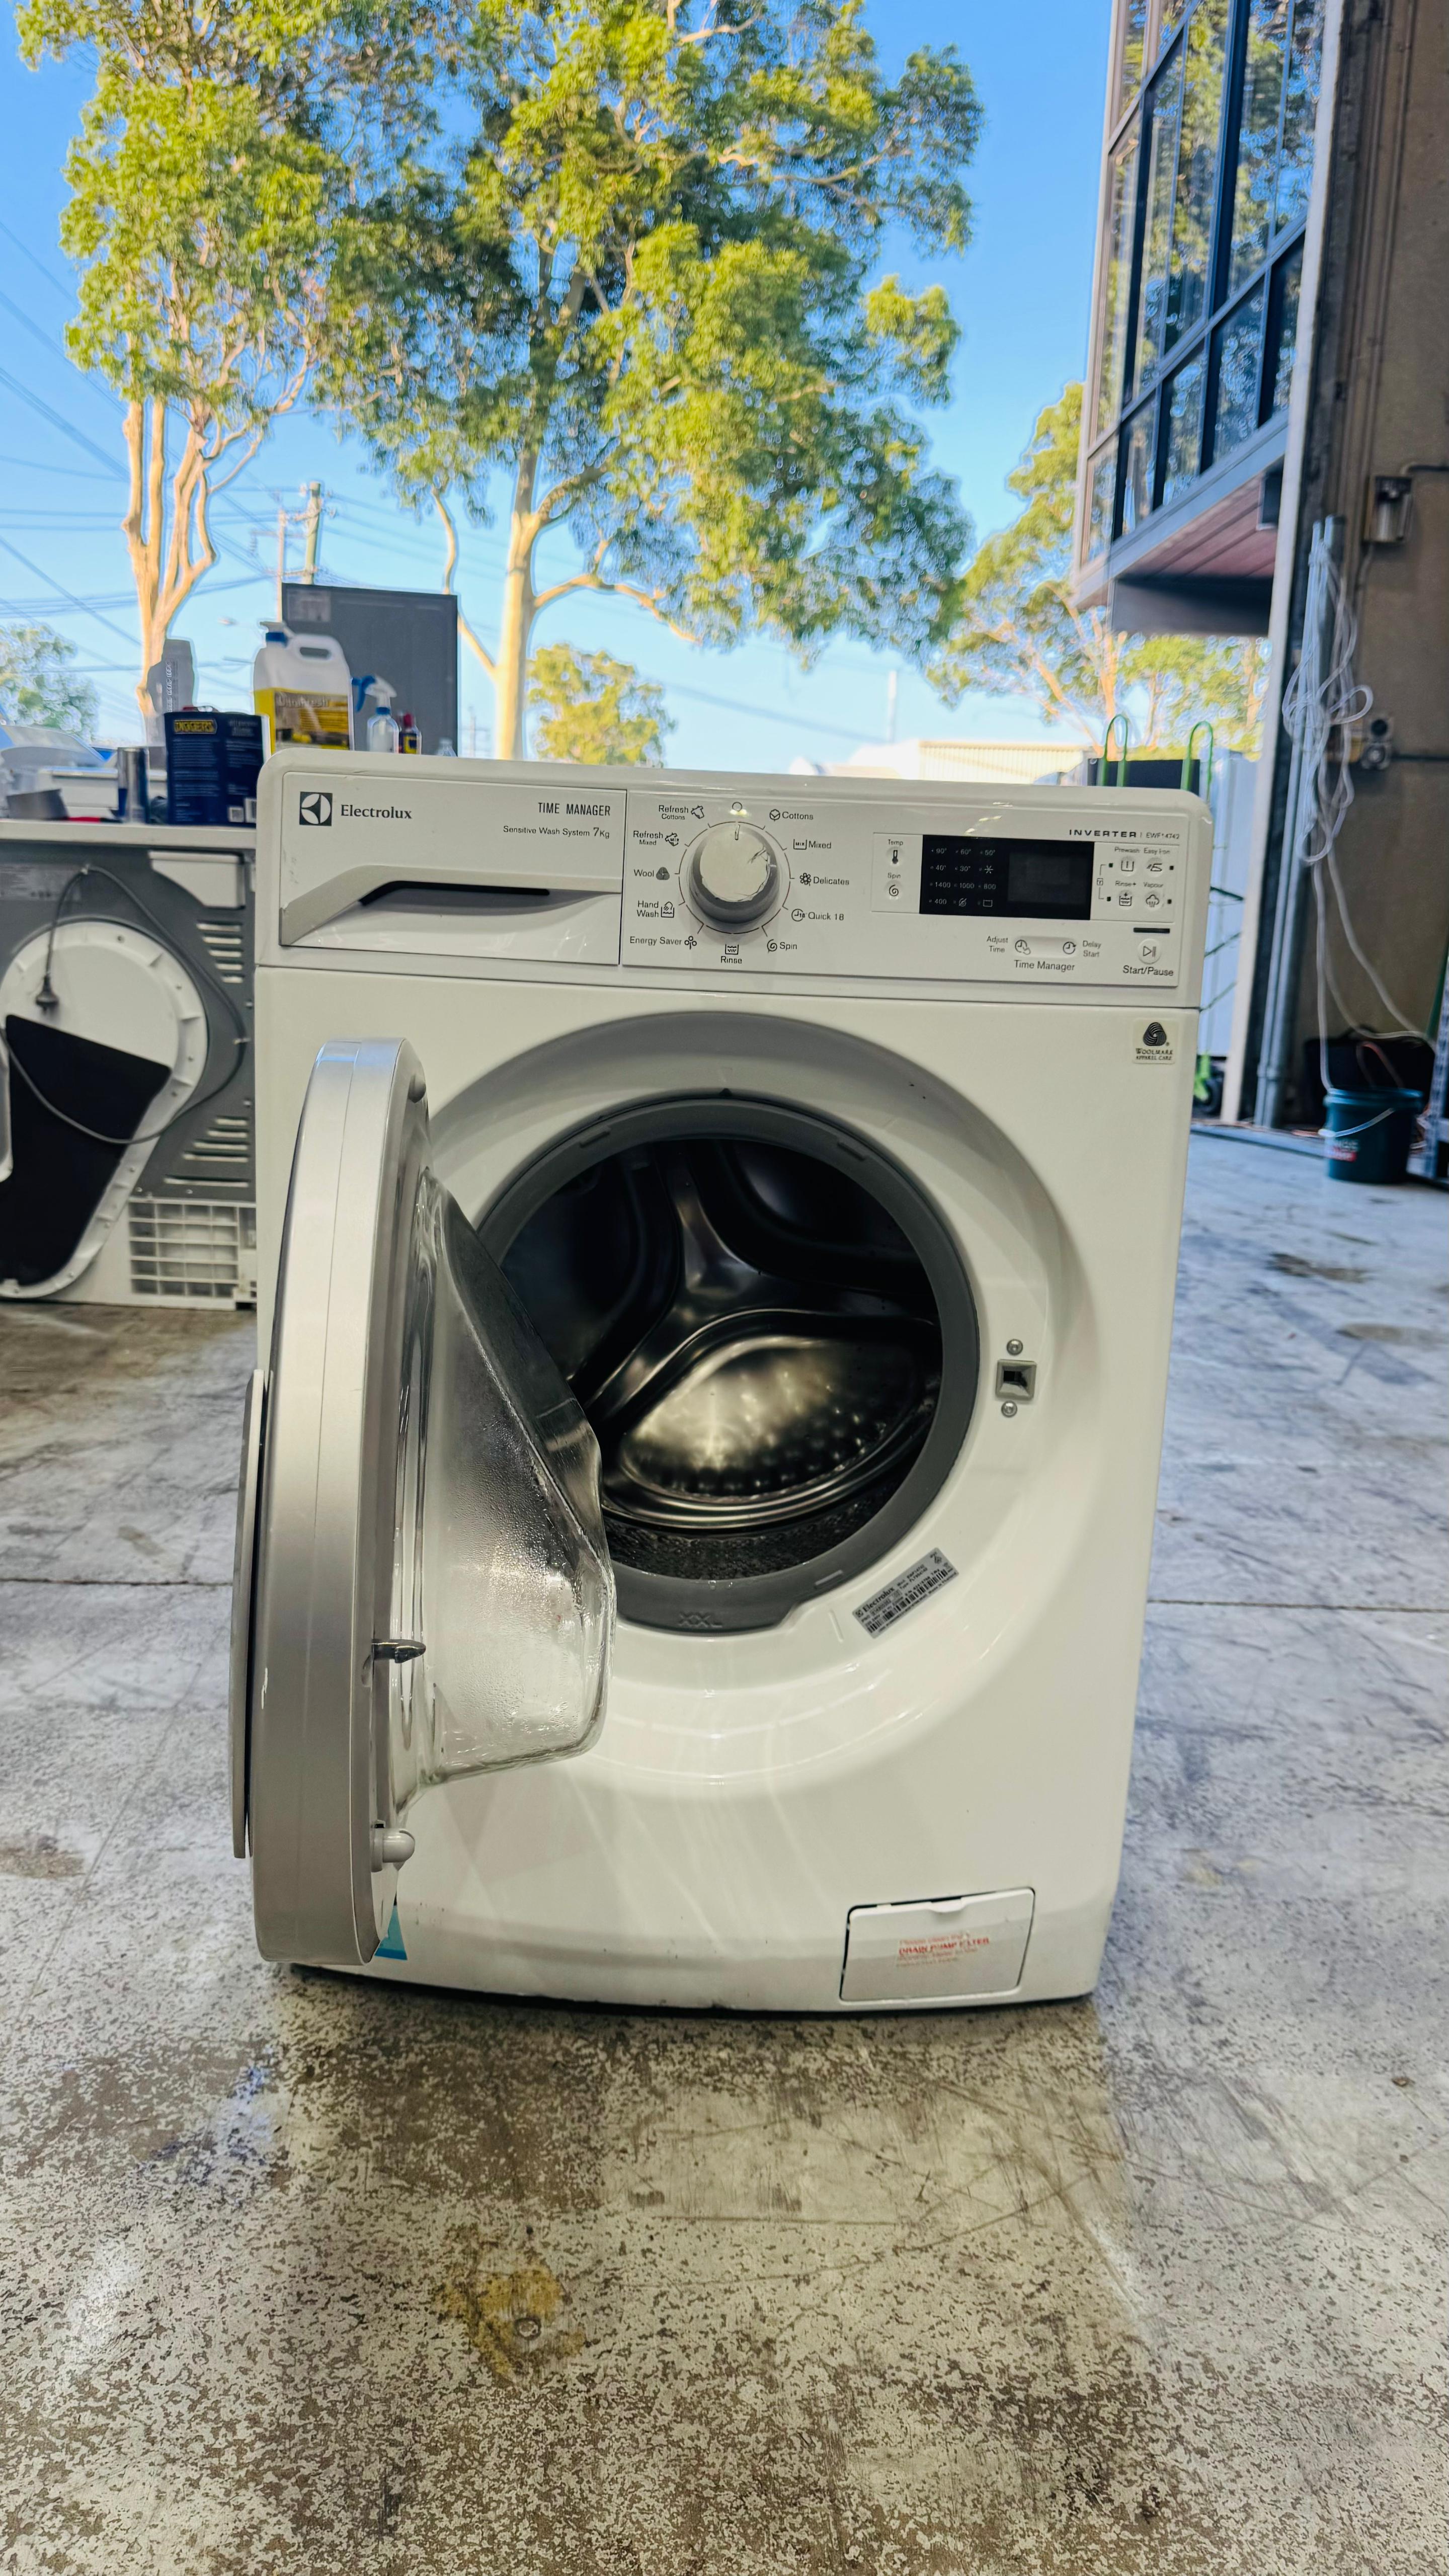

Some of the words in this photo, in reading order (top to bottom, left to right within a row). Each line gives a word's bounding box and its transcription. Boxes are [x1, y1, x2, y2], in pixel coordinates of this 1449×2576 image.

[341, 804, 412, 819] Electrolux
[538, 802, 560, 814] TIME
[566, 803, 610, 816] MANAGER
[658, 805, 689, 813] Refresh
[782, 811, 814, 820] Cottons
[503, 825, 536, 834] Sensitive
[539, 827, 560, 835] Wash
[562, 828, 590, 837] System
[633, 830, 663, 839] Refresh
[1069, 829, 1137, 838] INVERTER
[809, 840, 832, 849] Mixed
[633, 869, 654, 877] Wool
[813, 876, 850, 886] Delicates
[637, 900, 659, 909] Hand
[636, 909, 659, 918] Wash
[808, 912, 831, 920] Quick
[629, 936, 657, 946] Energy
[660, 936, 682, 945] Saver
[986, 935, 1008, 944] Adjust
[779, 942, 797, 951] Spin
[989, 945, 1005, 953] Time
[1082, 940, 1101, 949] Delay
[1083, 949, 1100, 958] Start
[720, 955, 742, 964] Rinse
[1014, 959, 1034, 969] Time
[1037, 960, 1075, 972] Manager
[1122, 965, 1174, 977] Start/Pause
[862, 1587, 895, 1613] Electrolux
